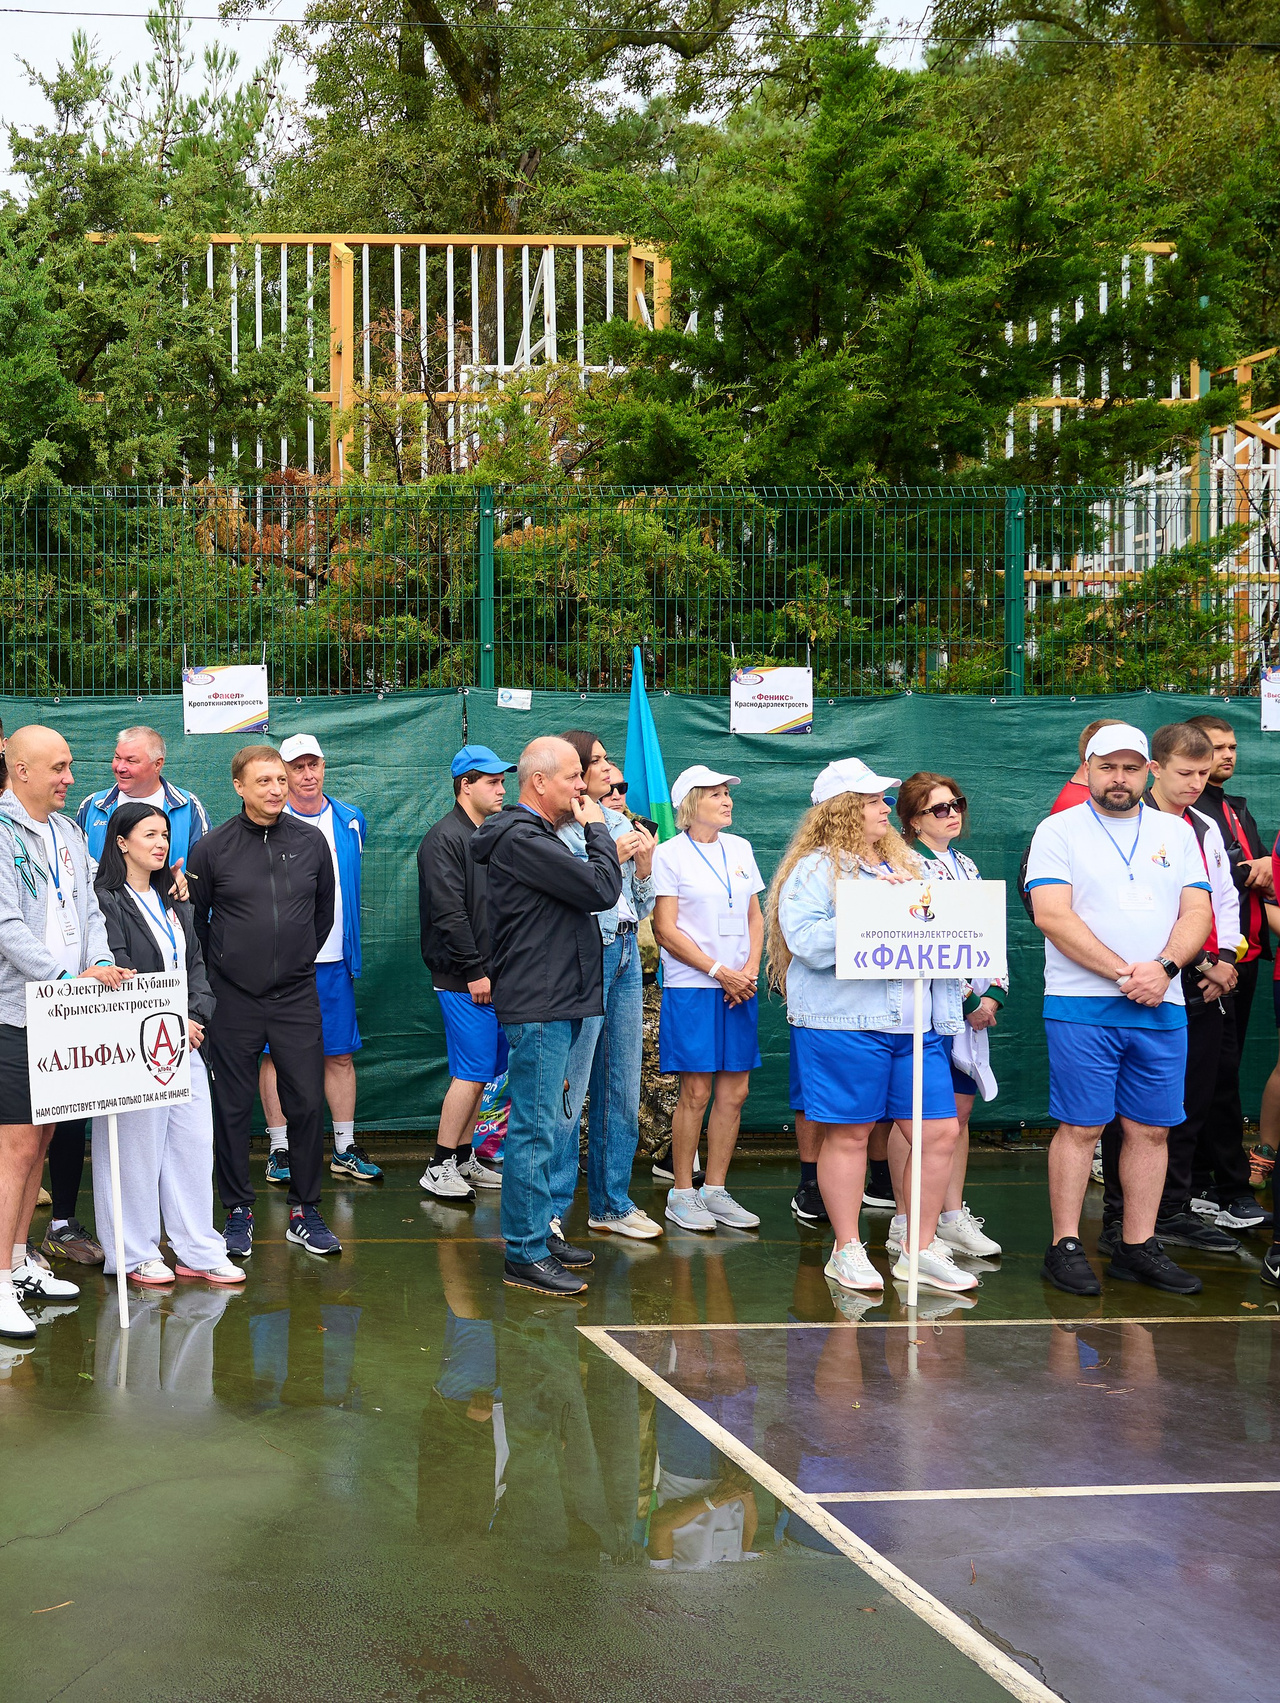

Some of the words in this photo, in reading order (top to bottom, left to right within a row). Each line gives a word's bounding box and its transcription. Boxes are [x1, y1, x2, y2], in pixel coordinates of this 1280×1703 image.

[188, 700, 263, 708] Кропоткинэлектросеть
[860, 930, 984, 939] «КРОПОТКИНЭЛЕКТРОСЕТЬ»
[853, 943, 991, 970] «ФАКЕЛ»
[35, 984, 54, 999] АО
[137, 976, 181, 993] Кубани»
[47, 998, 171, 1020] «Крымскэлектросеть»
[36, 1042, 136, 1073] «АЛЬФА»
[35, 1107, 51, 1118] НАМ
[51, 1100, 96, 1116] СОПУТСТВУЕТ
[97, 1098, 118, 1110] УДАЧА
[118, 1094, 142, 1106] ТОЛЬКО
[143, 1093, 154, 1103] ТАК
[154, 1092, 160, 1101] А
[159, 1090, 168, 1100] НЕ
